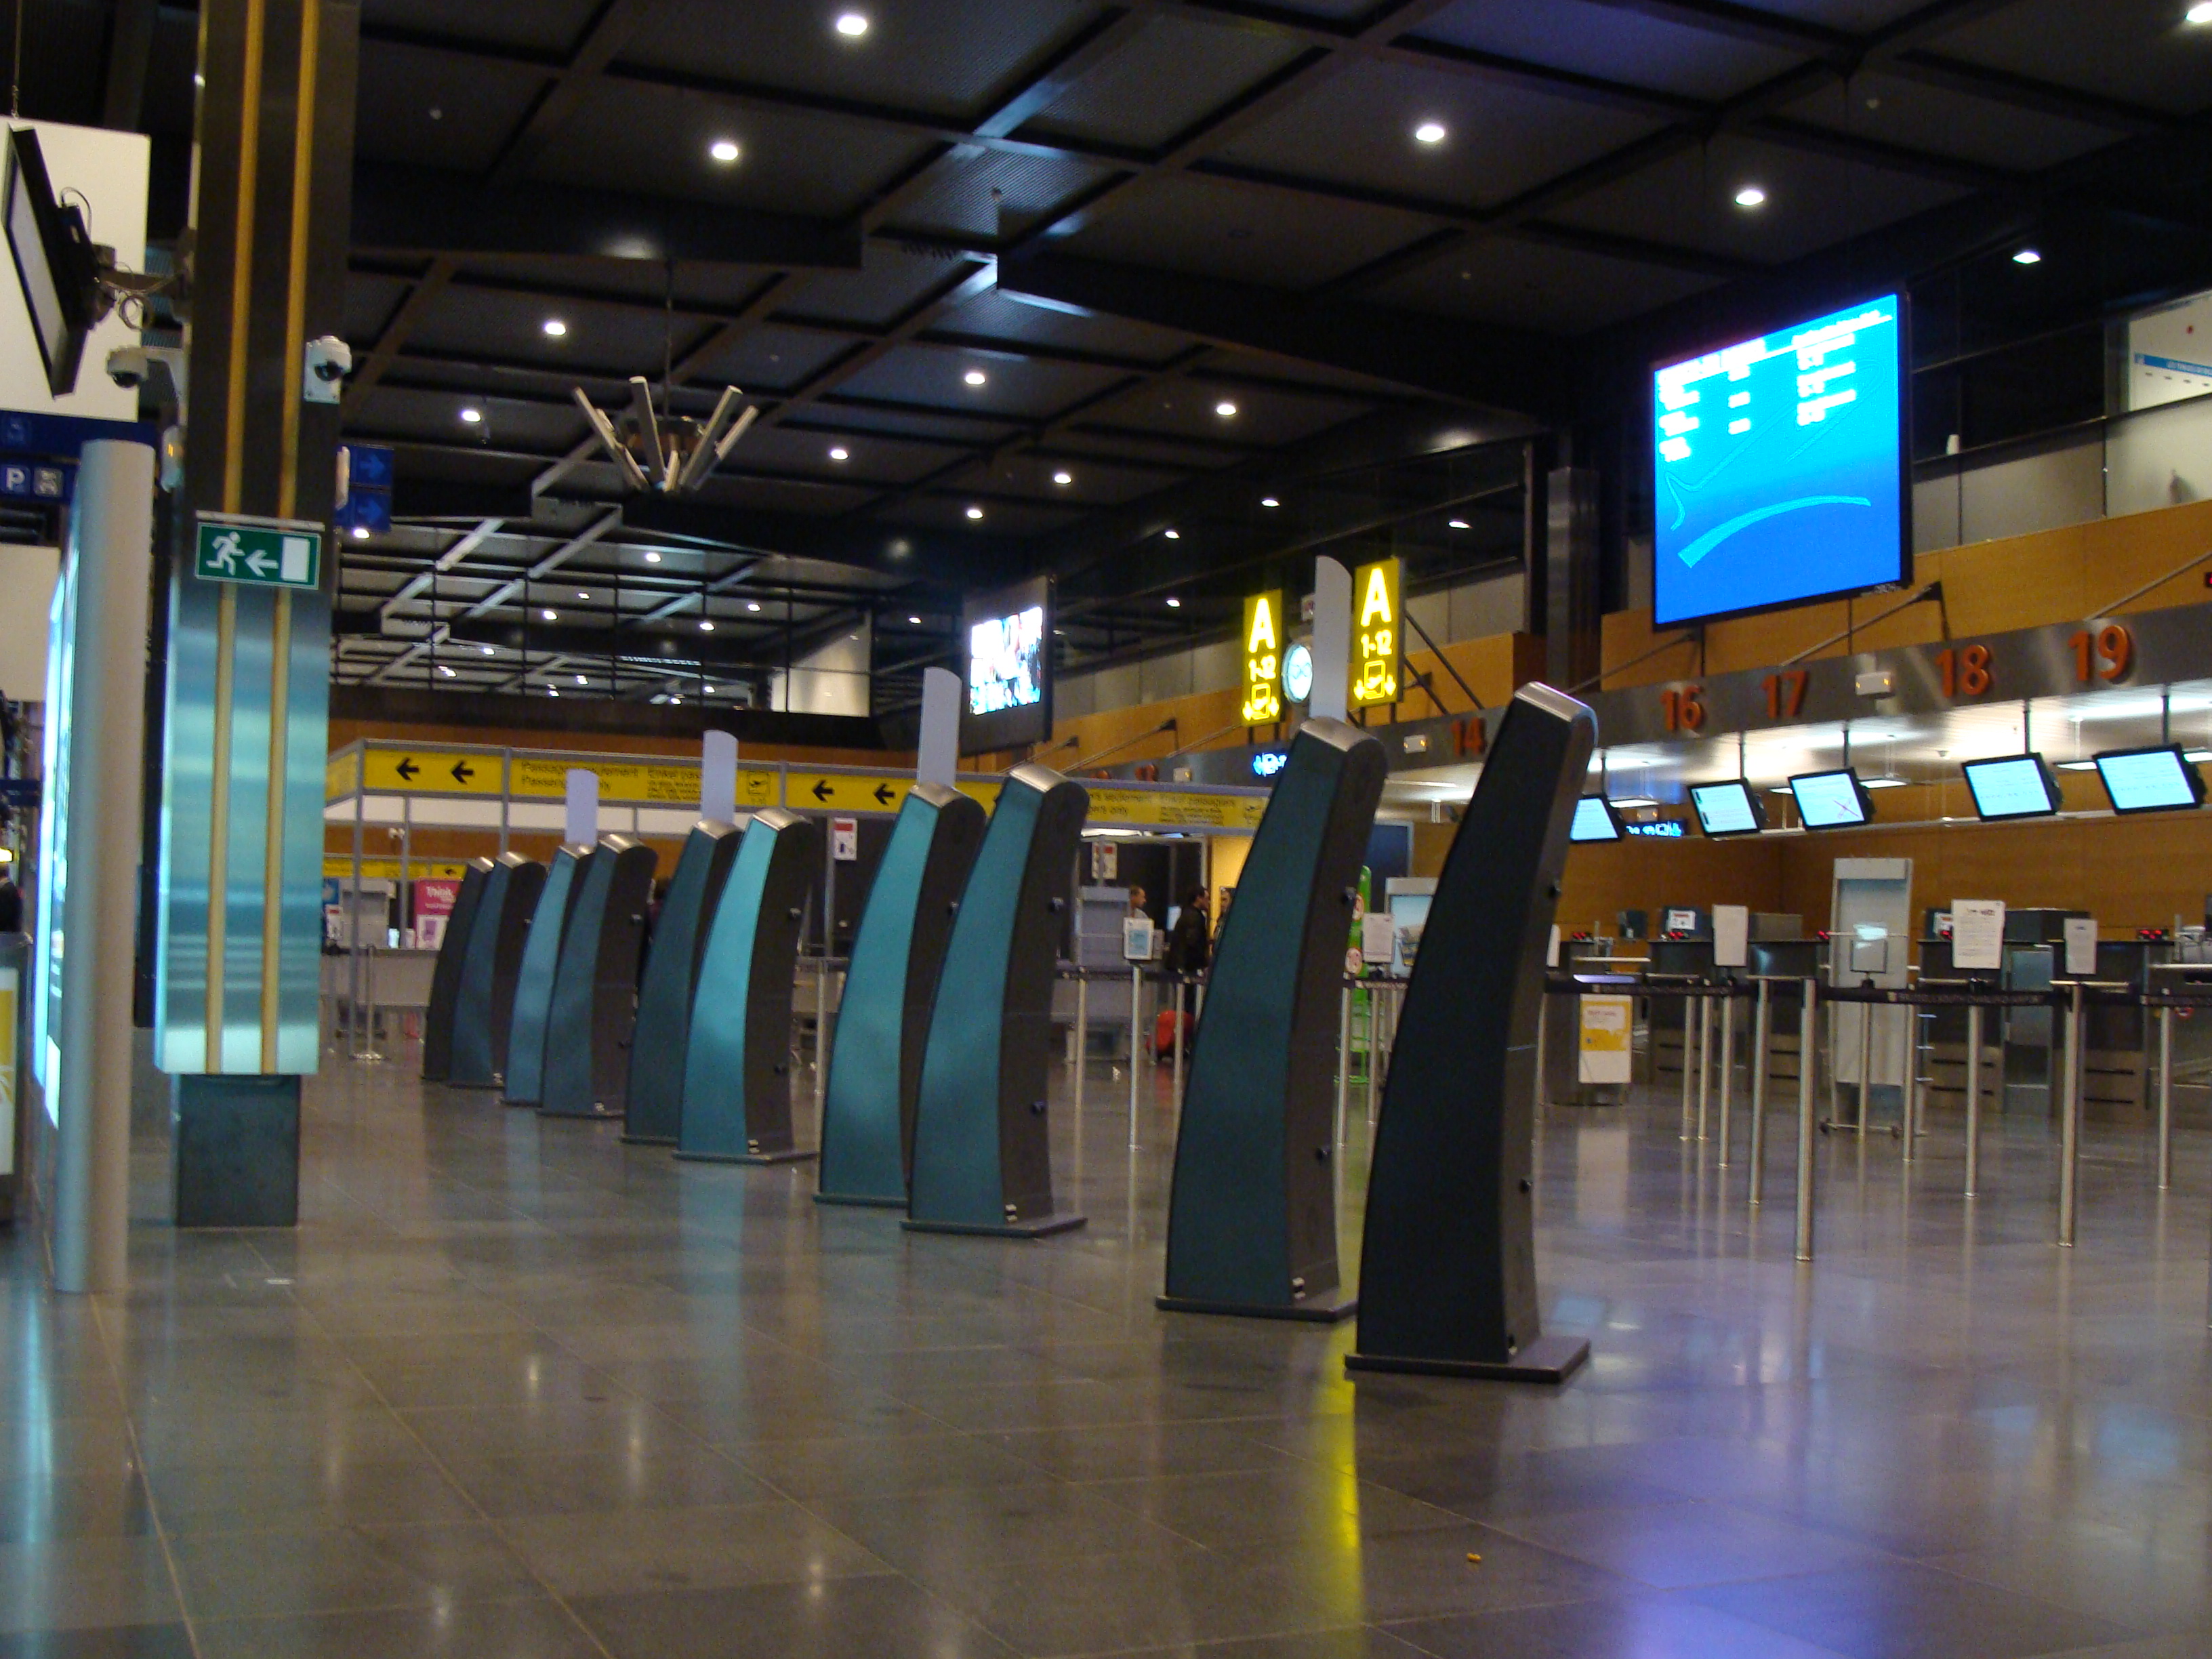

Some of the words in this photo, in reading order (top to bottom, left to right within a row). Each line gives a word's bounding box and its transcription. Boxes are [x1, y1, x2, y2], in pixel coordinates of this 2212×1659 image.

[6, 467, 25, 491] P
[1360, 567, 1392, 627] A
[1248, 598, 1276, 653] A
[1360, 629, 1393, 659] 1-12
[1936, 644, 1989, 698] 18
[2069, 625, 2129, 681] 19
[1660, 685, 1701, 731] 16
[1762, 670, 1808, 719] 17
[1450, 717, 1482, 756] 14
